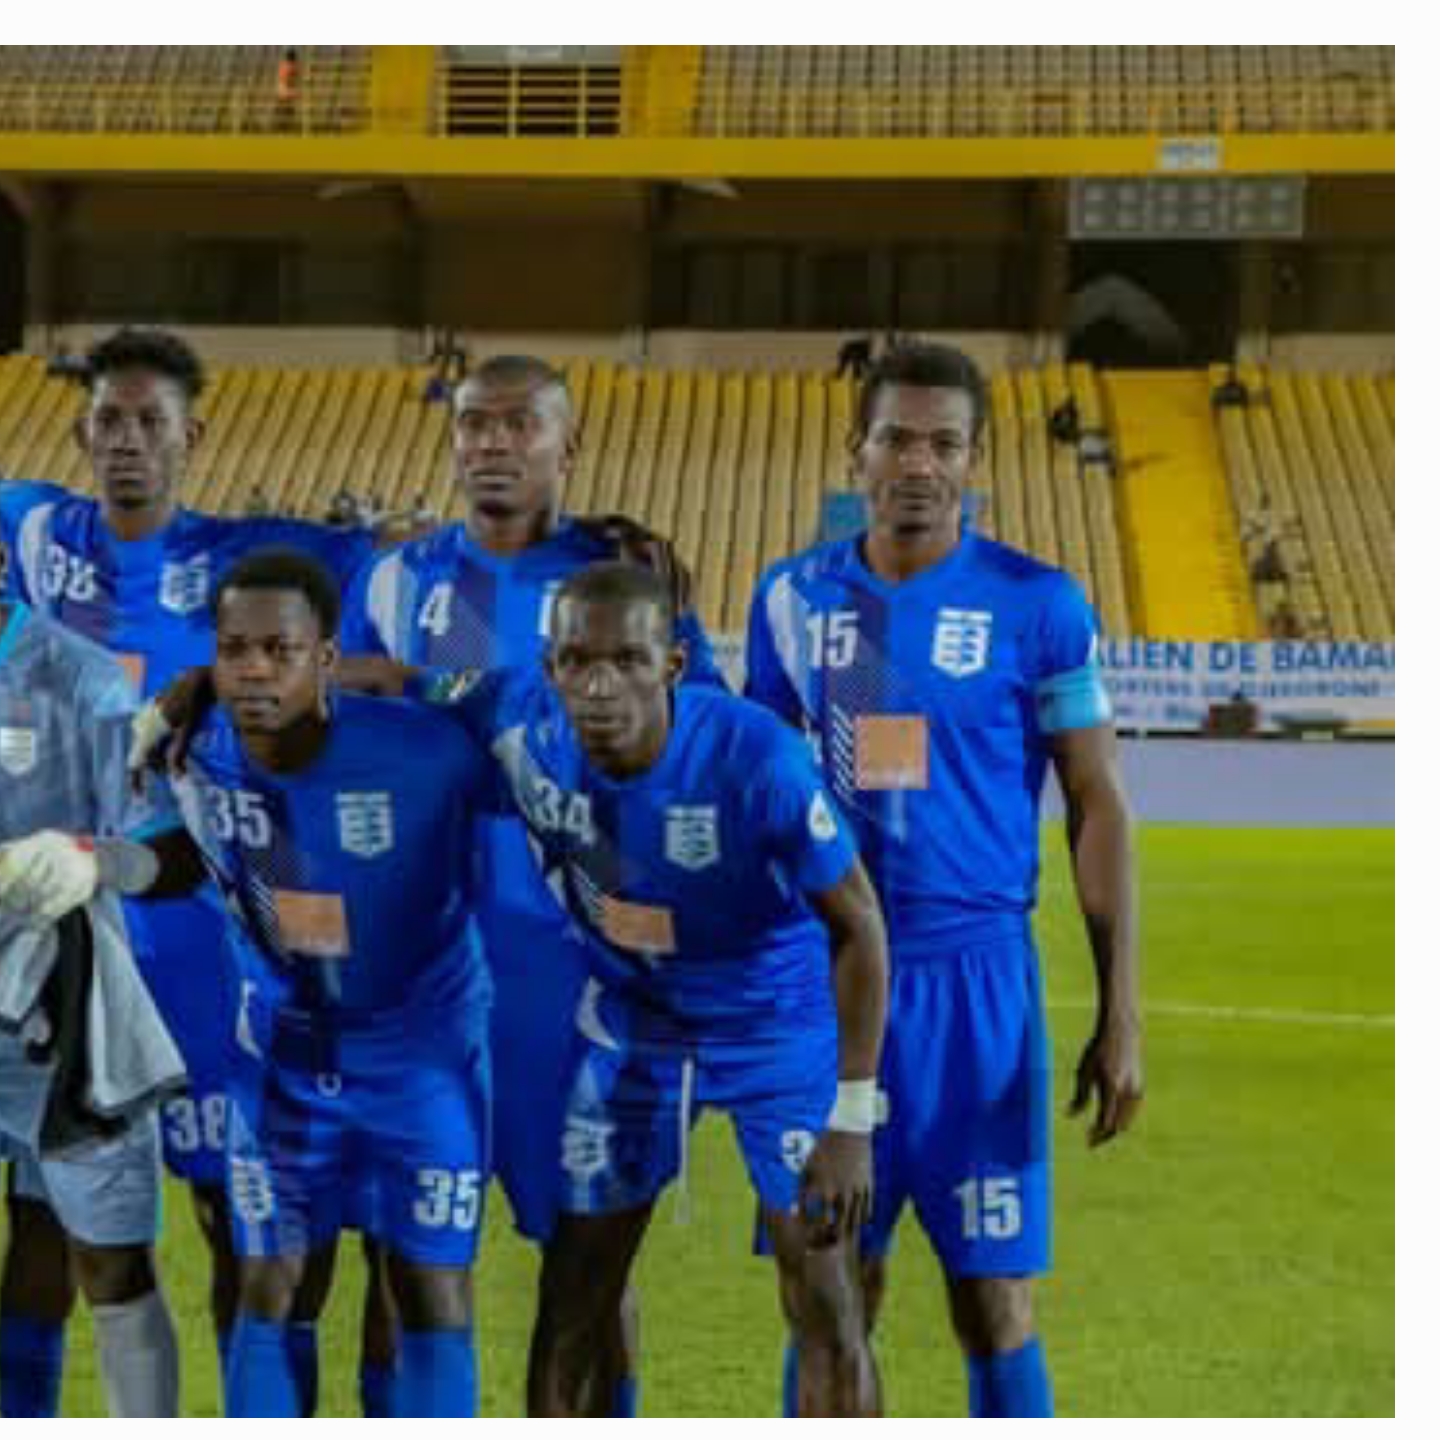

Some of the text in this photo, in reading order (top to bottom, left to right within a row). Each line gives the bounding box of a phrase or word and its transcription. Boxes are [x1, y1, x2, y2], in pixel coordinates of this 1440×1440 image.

[418, 582, 454, 636] 4
[805, 611, 860, 668] 15
[1209, 642, 1258, 669] DE
[209, 791, 272, 847] 35
[528, 777, 599, 846] 34
[413, 1168, 481, 1230] 35
[955, 1177, 1022, 1239] 15
